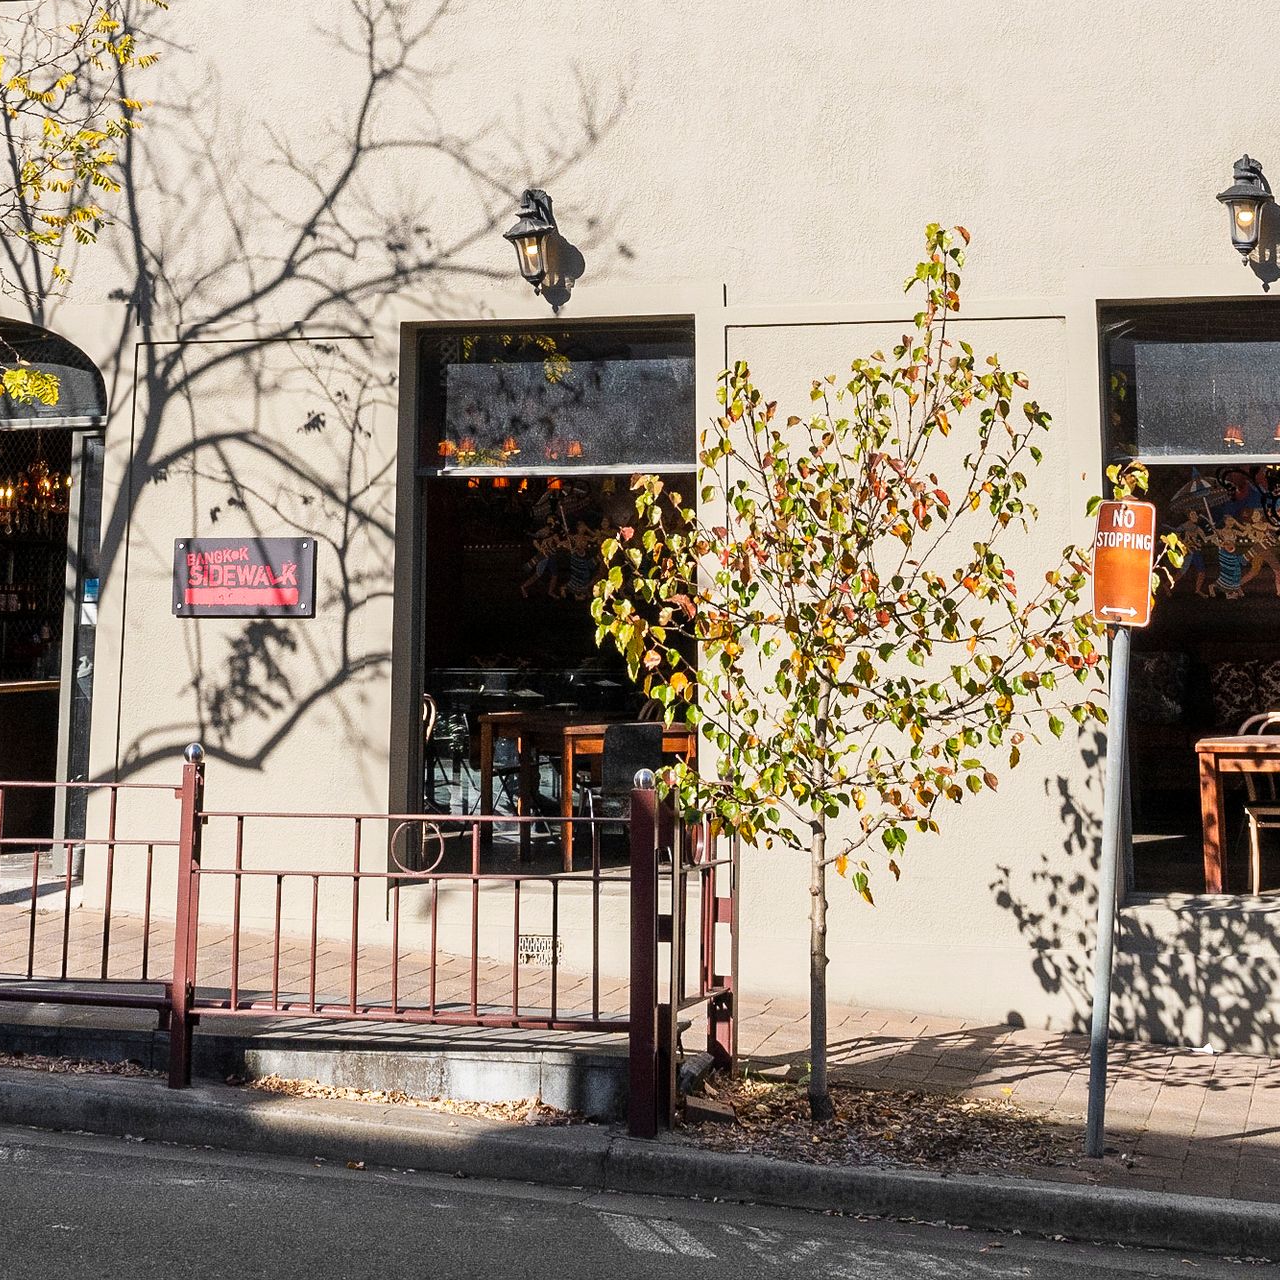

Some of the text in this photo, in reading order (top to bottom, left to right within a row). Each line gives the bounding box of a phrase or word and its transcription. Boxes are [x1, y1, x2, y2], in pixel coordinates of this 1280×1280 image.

[1113, 509, 1135, 529] NO
[1096, 531, 1152, 551] STOPPING
[186, 545, 250, 567] BANGKOK
[188, 561, 298, 587] SIDEWALK
